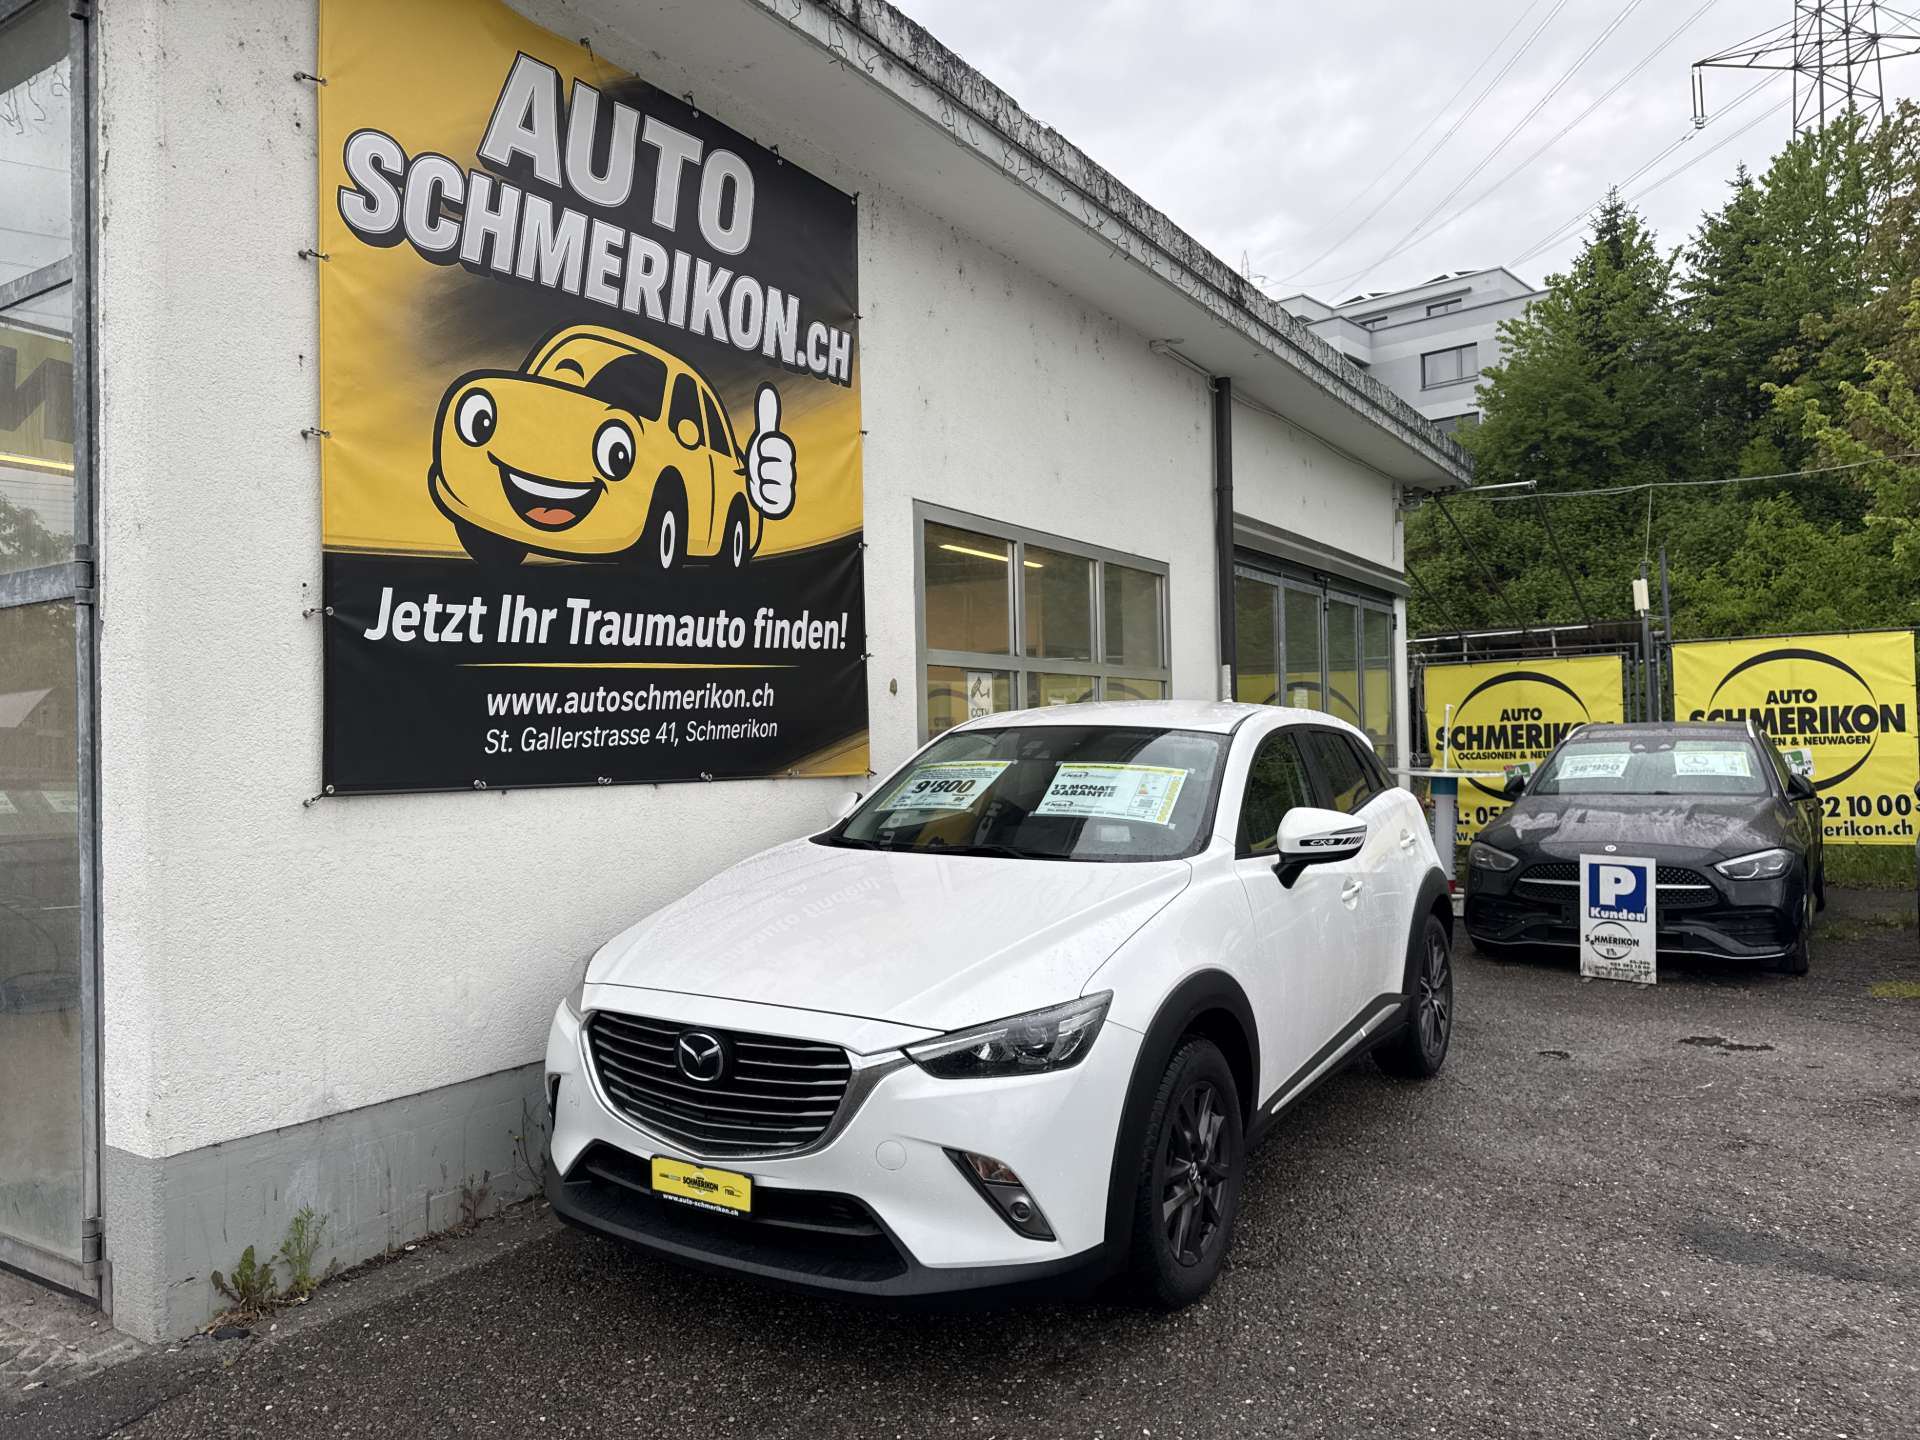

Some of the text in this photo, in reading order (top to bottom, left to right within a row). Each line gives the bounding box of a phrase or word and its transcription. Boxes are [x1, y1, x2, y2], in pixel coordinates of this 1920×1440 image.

[480, 51, 755, 256] AUTO
[338, 130, 852, 385] SCHMERIKON.CH
[363, 587, 849, 650] Jetzt Ihr Traumauto finden!
[486, 683, 775, 716] www.autoschmerikon.ch
[1766, 688, 1818, 705] AUTO
[1500, 707, 1542, 722] AUTO
[485, 718, 778, 754] St. Gallerstrasse 41, Schmerikon
[1803, 735, 1871, 746] NEUWAGEN
[1458, 751, 1517, 761] OCCASIONEN
[912, 779, 977, 794] 9'800
[1068, 784, 1118, 792] MONATE
[1847, 795, 1873, 817] 10
[1600, 865, 1637, 907] P
[1590, 906, 1646, 922] Kunden
